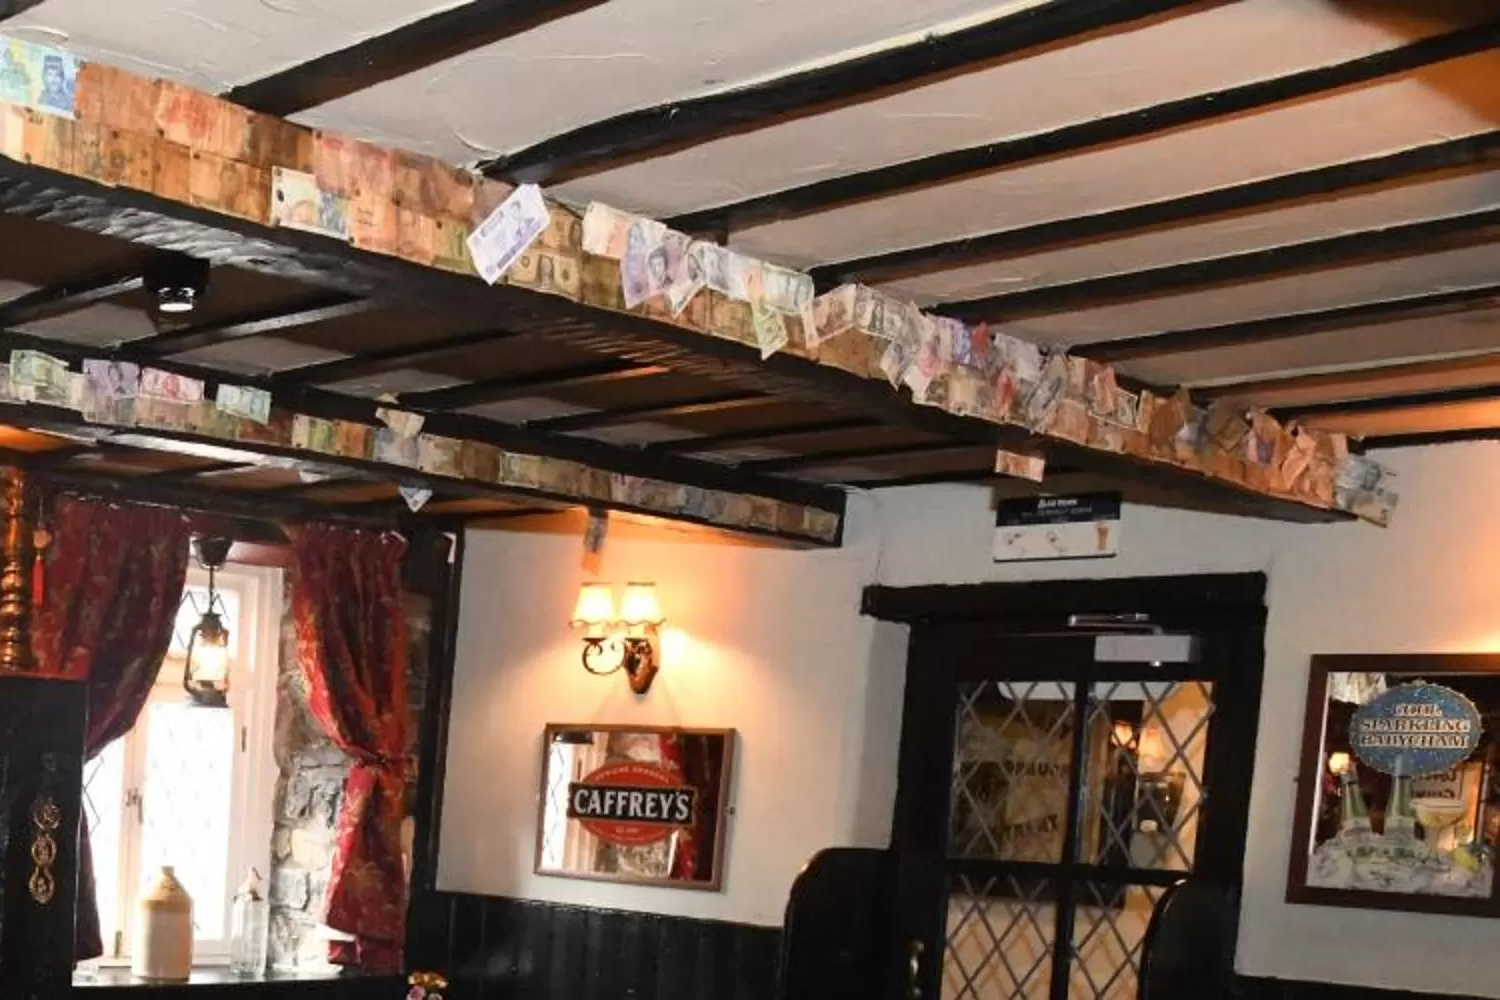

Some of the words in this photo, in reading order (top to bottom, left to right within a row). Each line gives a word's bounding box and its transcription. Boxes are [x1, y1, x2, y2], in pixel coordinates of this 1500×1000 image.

[1362, 718, 1471, 733] SPARKLING
[1361, 734, 1468, 748] BABYCHAM
[573, 788, 690, 820] CAFFREY'S
